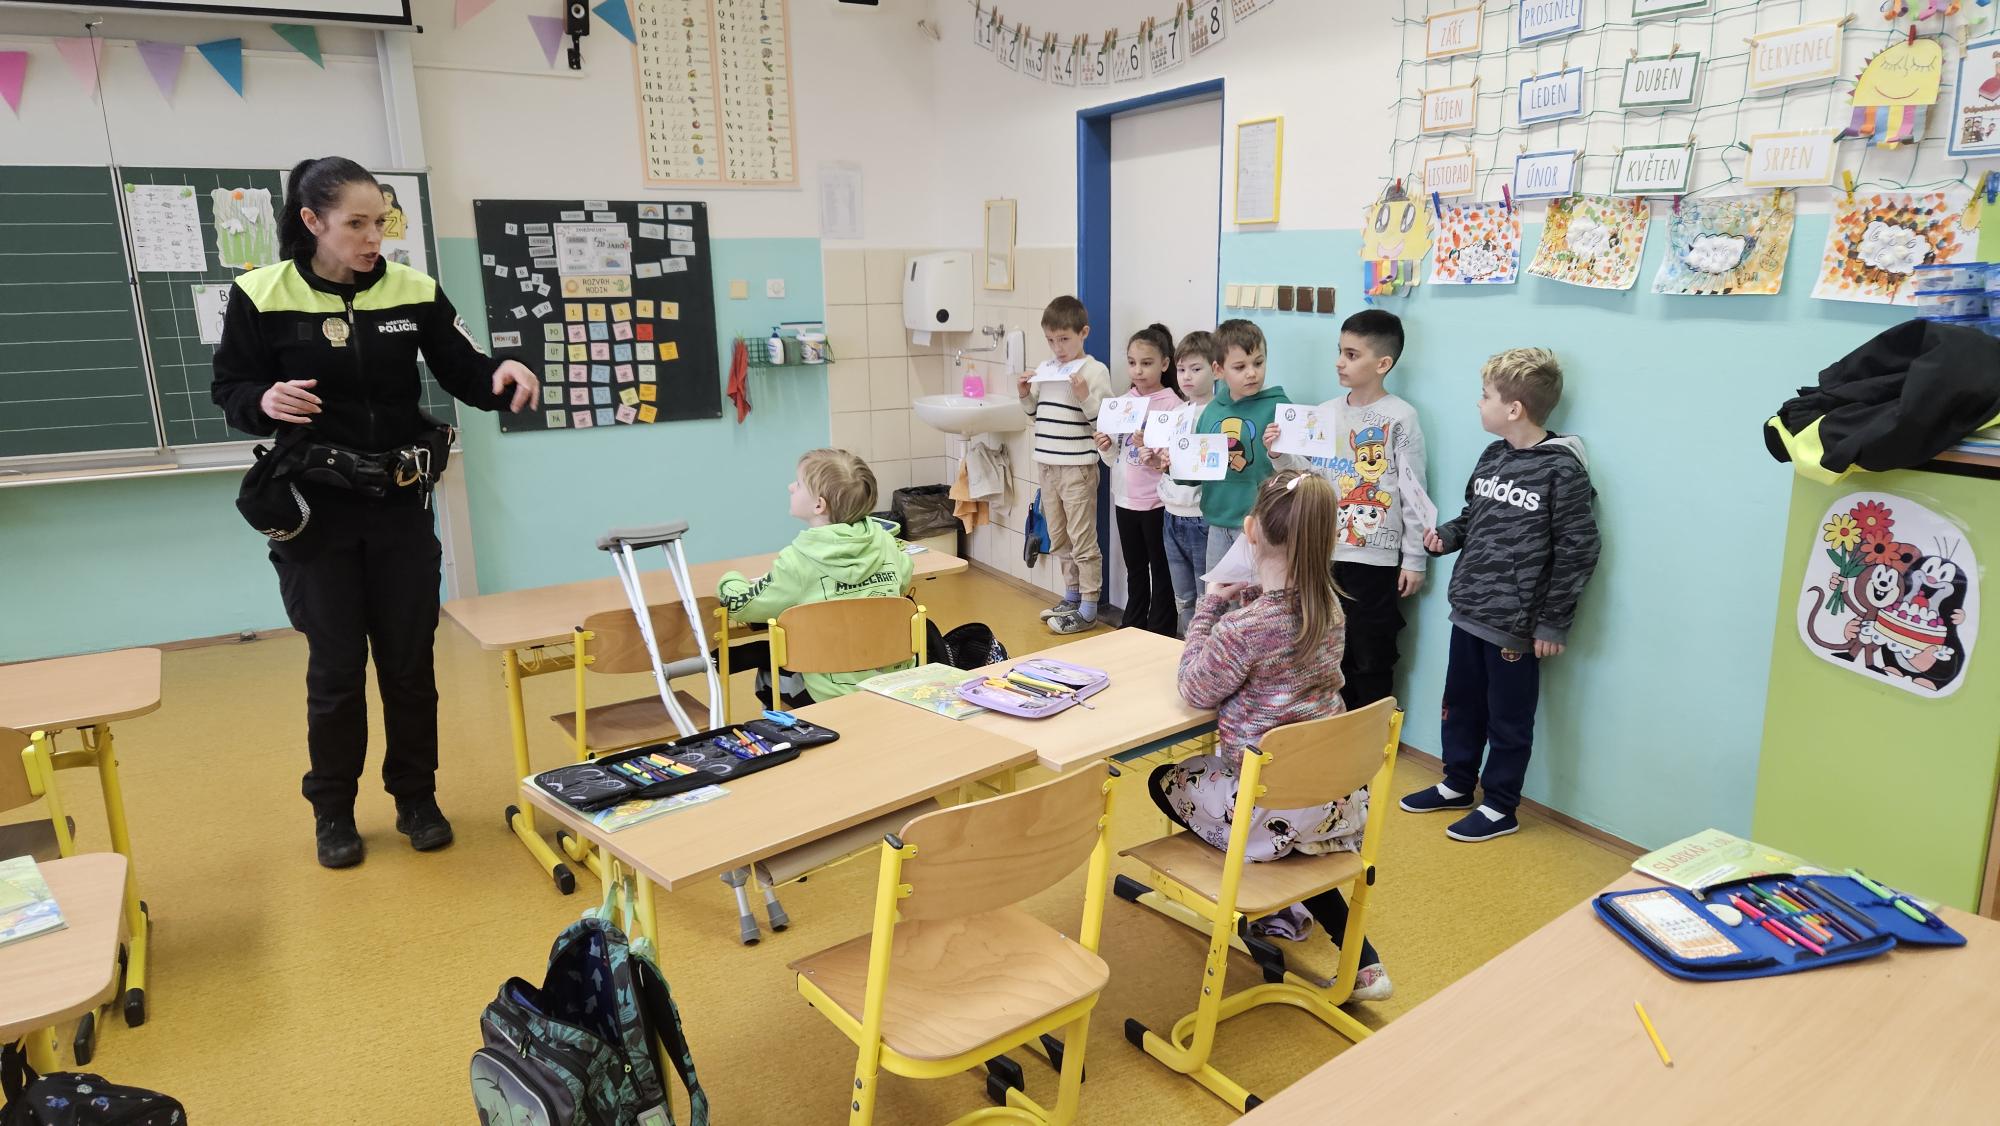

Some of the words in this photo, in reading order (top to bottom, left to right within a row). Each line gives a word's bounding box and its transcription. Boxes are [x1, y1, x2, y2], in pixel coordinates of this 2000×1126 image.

[986, 21, 992, 44] 1
[1210, 6, 1220, 35] 8
[1440, 17, 1465, 47] ZÁŘÍ
[1009, 39, 1015, 64] 2
[1129, 44, 1139, 71] 6
[1168, 31, 1177, 60] 7
[1759, 36, 1834, 72] ČERVENEC
[1035, 48, 1043, 73] 3
[1064, 54, 1072, 79] 4
[1096, 51, 1104, 77] 5
[1635, 67, 1683, 93] DUBEN
[1434, 95, 1464, 122] ŘÍJEN
[1531, 82, 1568, 110] LEDEN
[1625, 151, 1681, 183] KVĚTEN
[1763, 145, 1814, 172] SRPEN
[1428, 163, 1470, 187] LISTOPAD
[1526, 163, 1560, 189] ÚNOR
[378, 323, 418, 333] POLICIE
[1474, 476, 1541, 511] adidas
